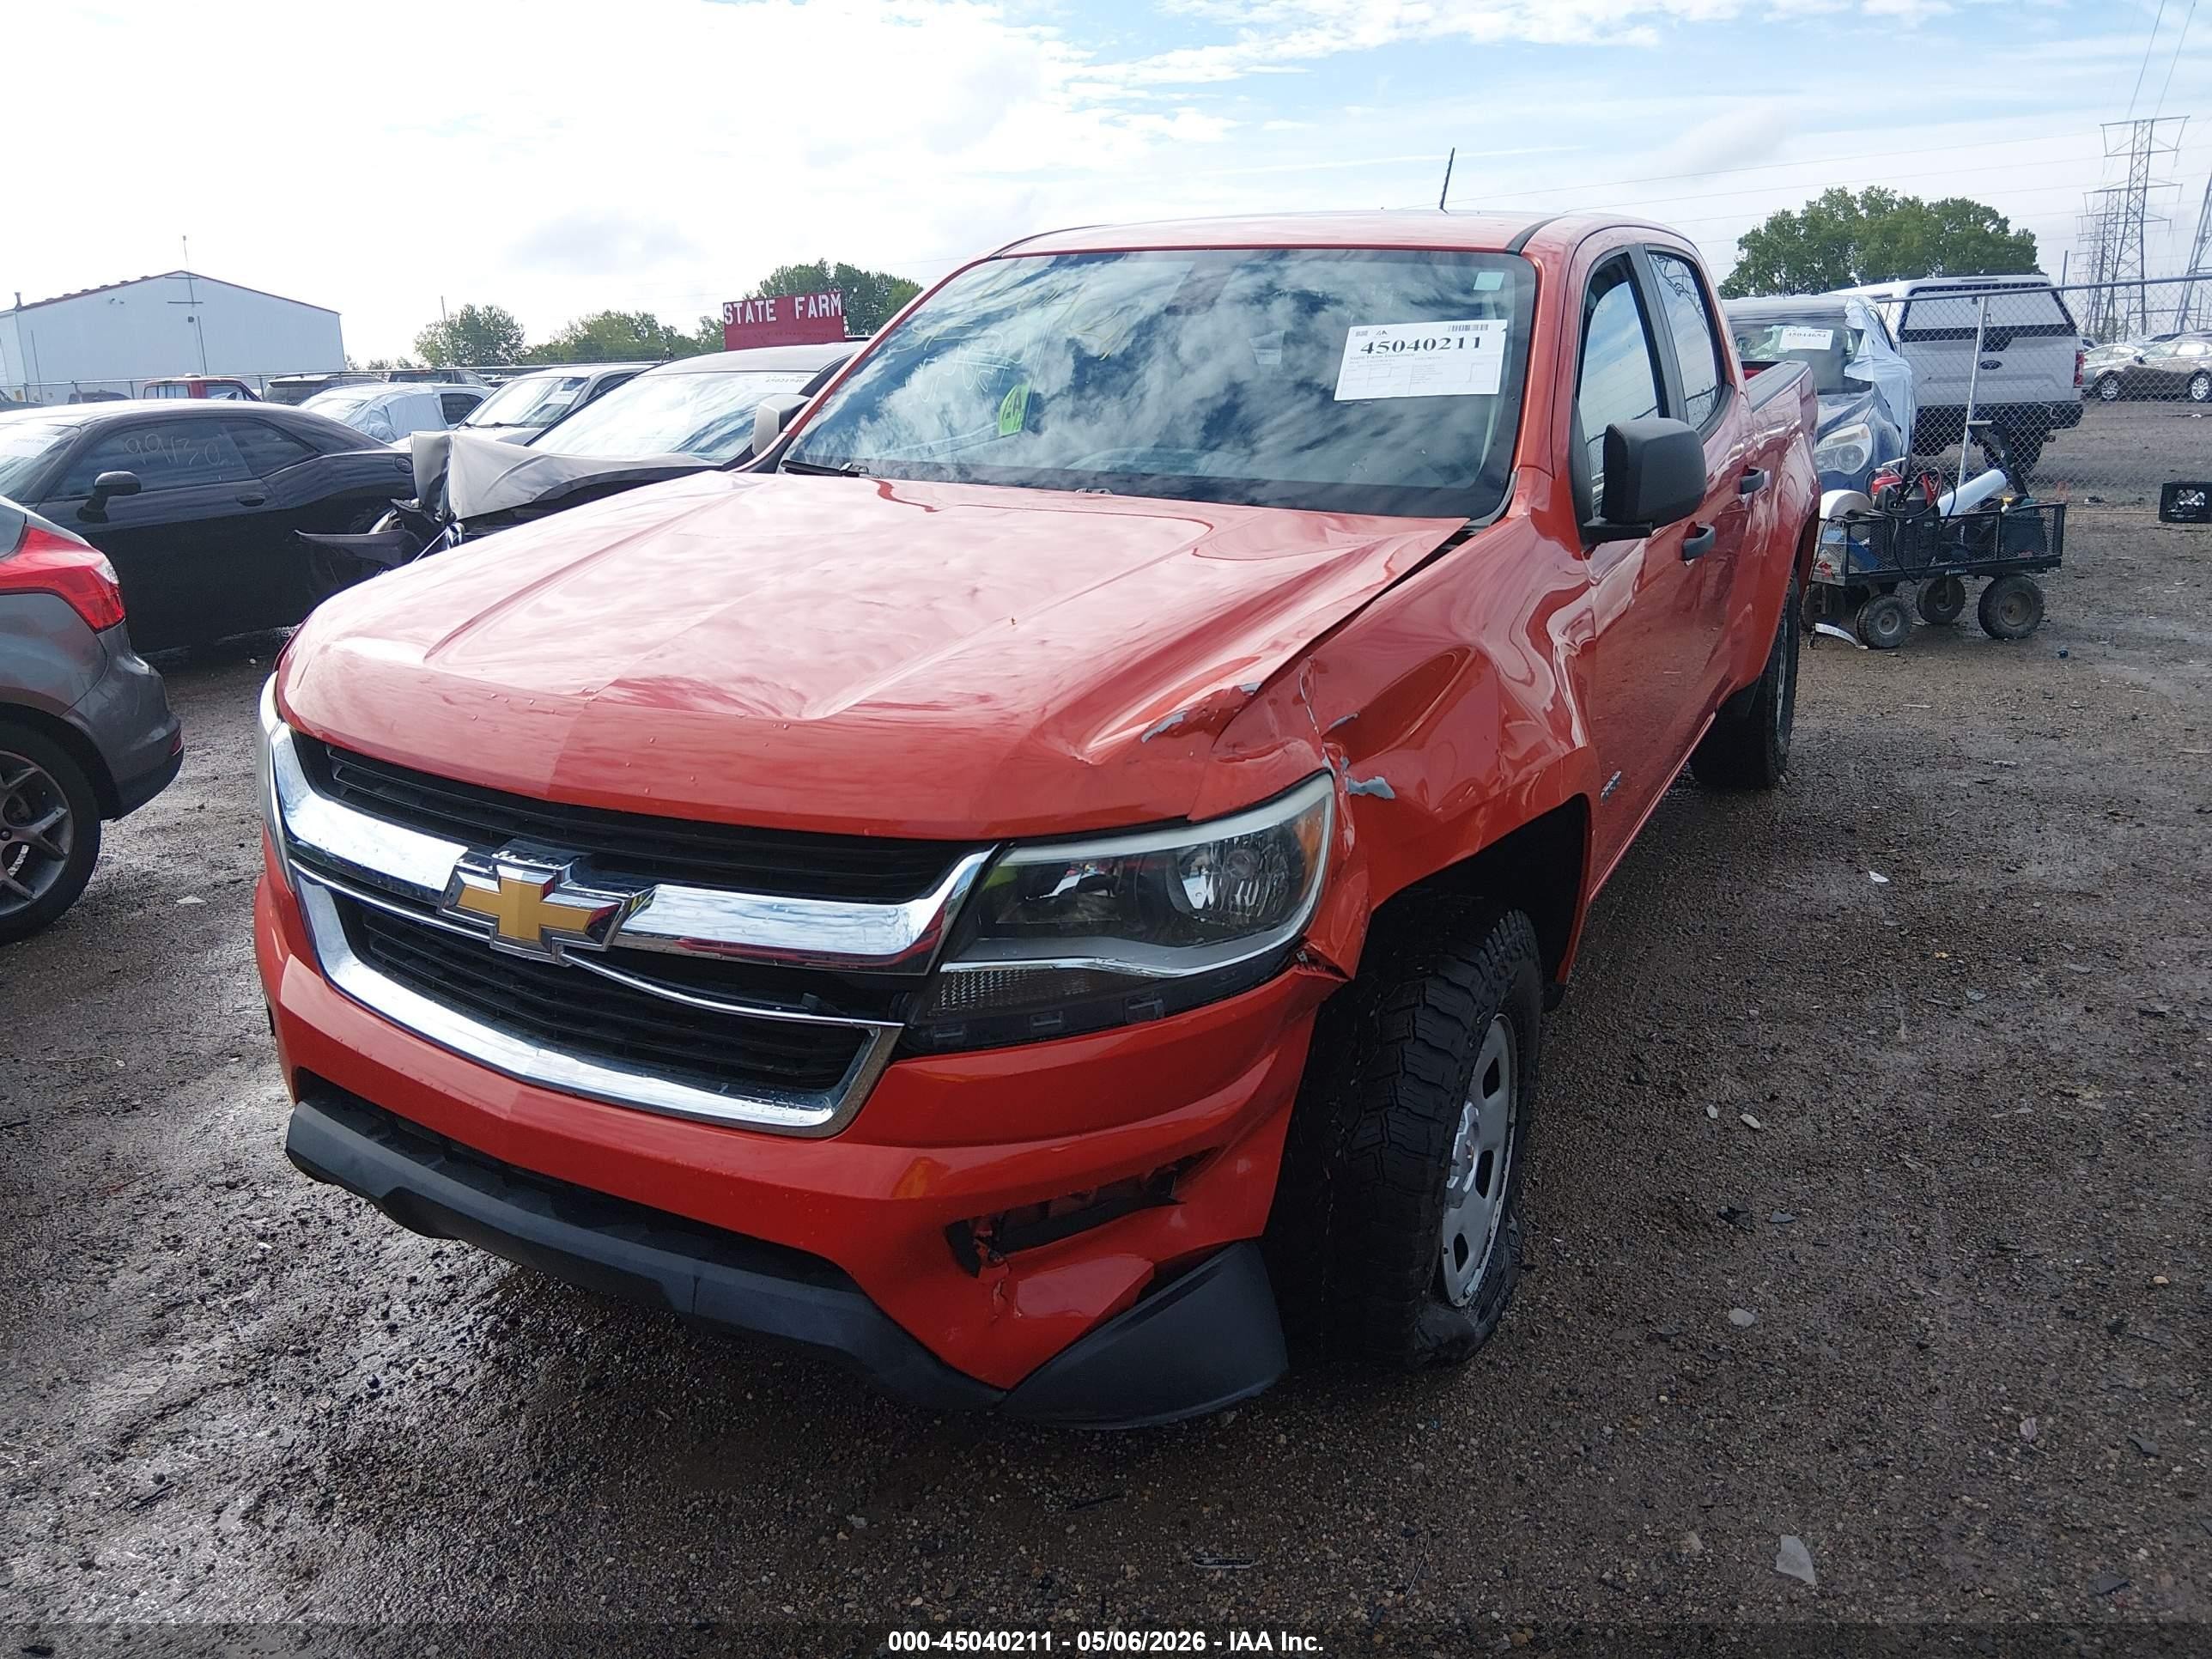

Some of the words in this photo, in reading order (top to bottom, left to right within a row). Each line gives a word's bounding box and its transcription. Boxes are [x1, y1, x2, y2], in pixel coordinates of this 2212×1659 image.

[724, 299, 776, 325] STATE
[794, 293, 842, 319] FARM
[1360, 336, 1481, 355] 45040211
